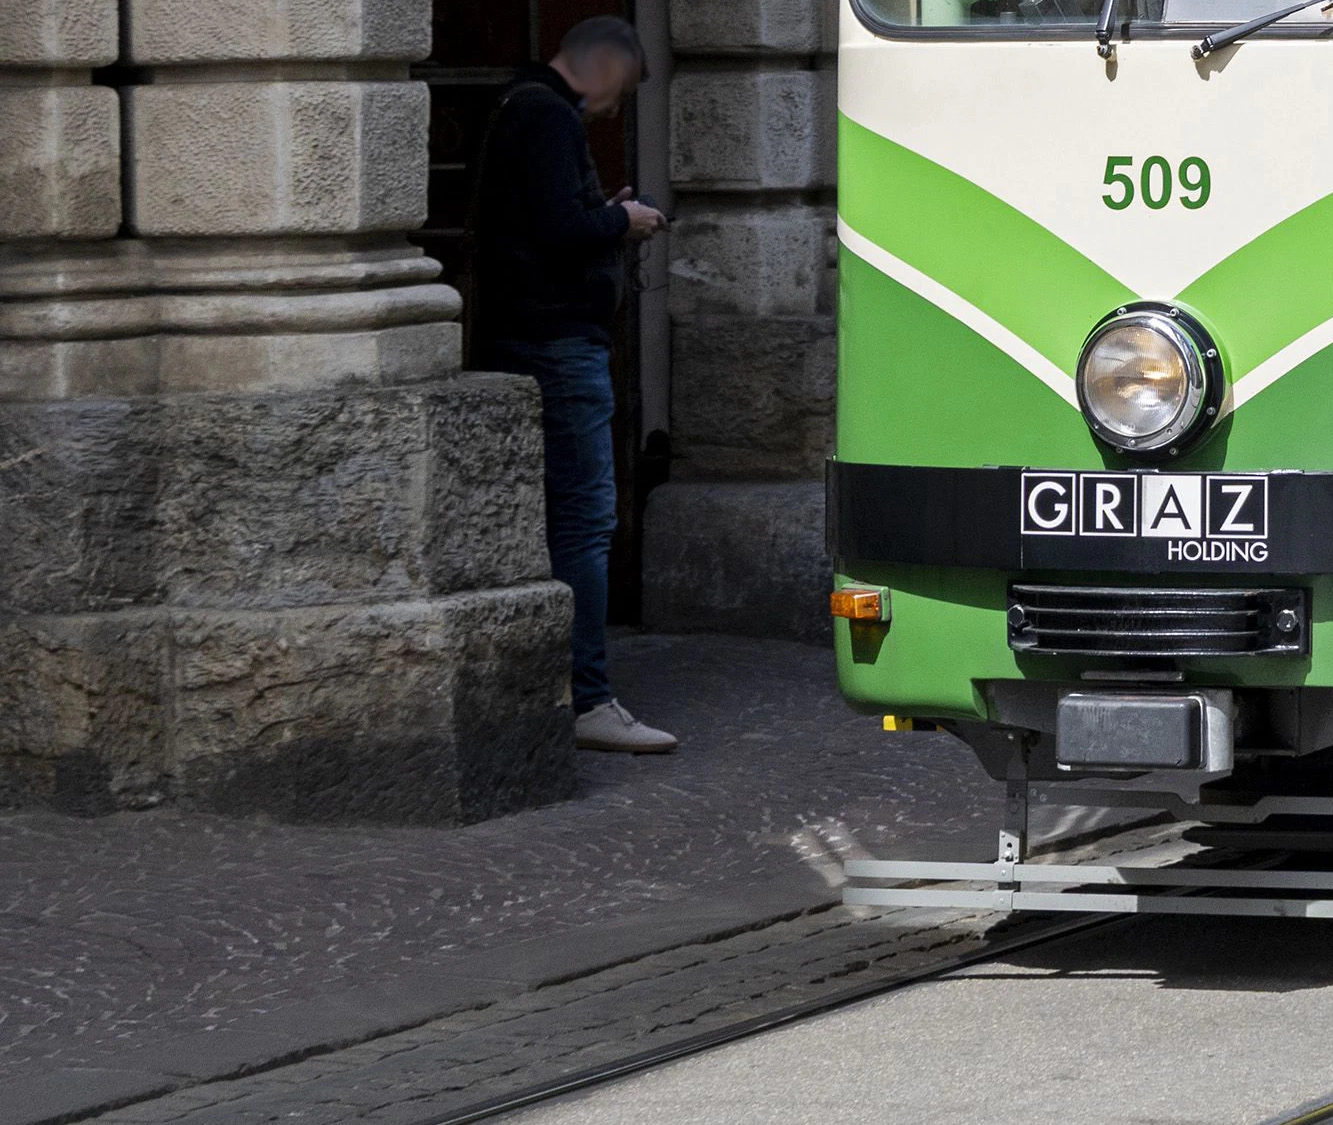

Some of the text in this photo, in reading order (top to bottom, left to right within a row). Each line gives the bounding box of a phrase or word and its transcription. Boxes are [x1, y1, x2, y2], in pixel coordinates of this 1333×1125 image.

[1101, 154, 1212, 212] 509
[1025, 477, 1258, 535] GRAZ
[1167, 540, 1269, 563] HOLDING
